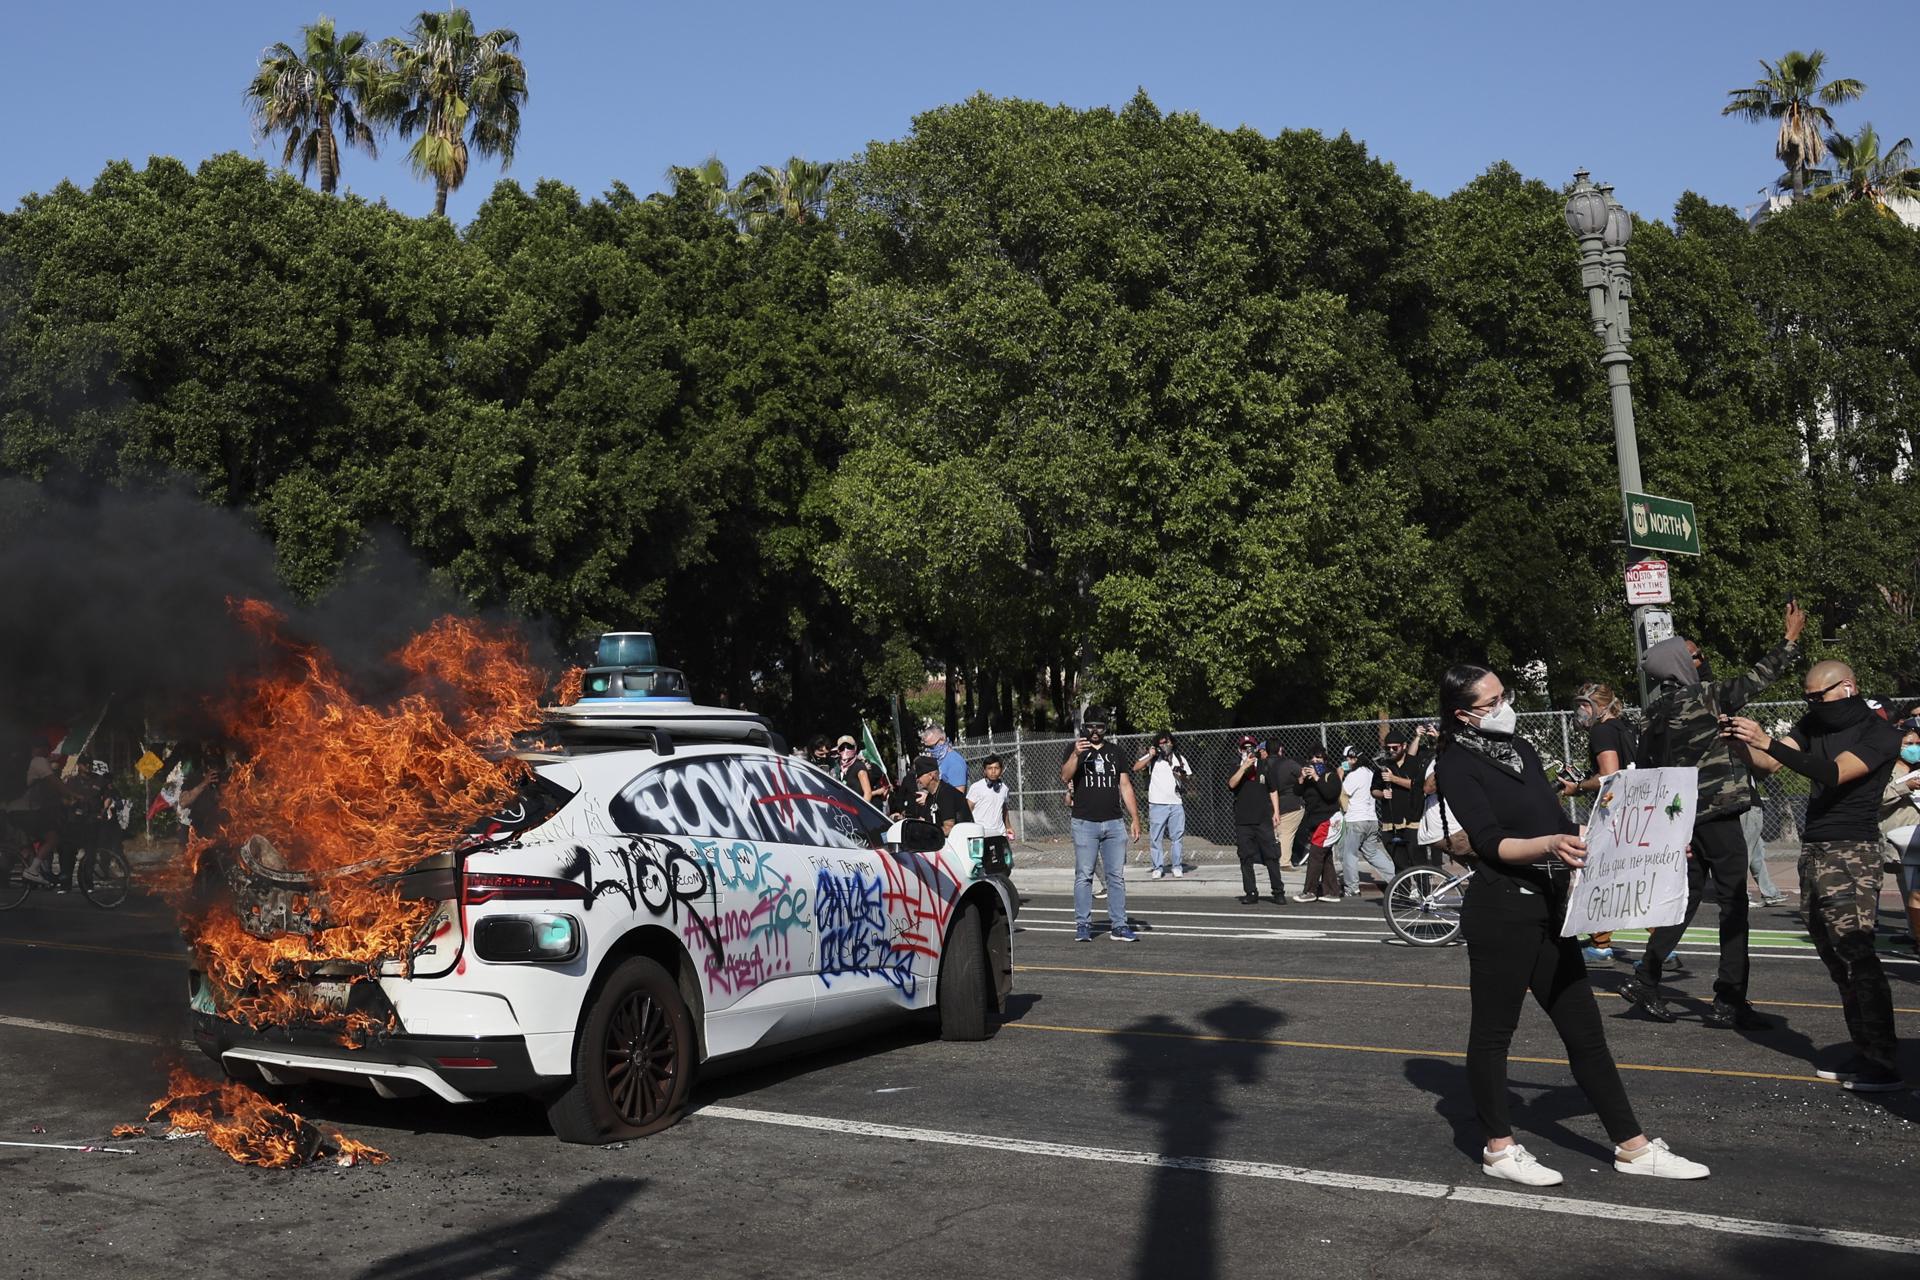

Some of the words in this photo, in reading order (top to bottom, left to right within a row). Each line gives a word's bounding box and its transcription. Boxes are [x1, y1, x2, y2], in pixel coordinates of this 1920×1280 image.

[1635, 512, 1646, 528] 101
[1650, 513, 1683, 536] NORTH
[1626, 571, 1640, 581] NO
[1641, 571, 1666, 579] STOING
[1611, 806, 1656, 848] VOZ
[1612, 857, 1626, 879] que
[1629, 855, 1643, 868] no
[1643, 844, 1680, 876] pueden
